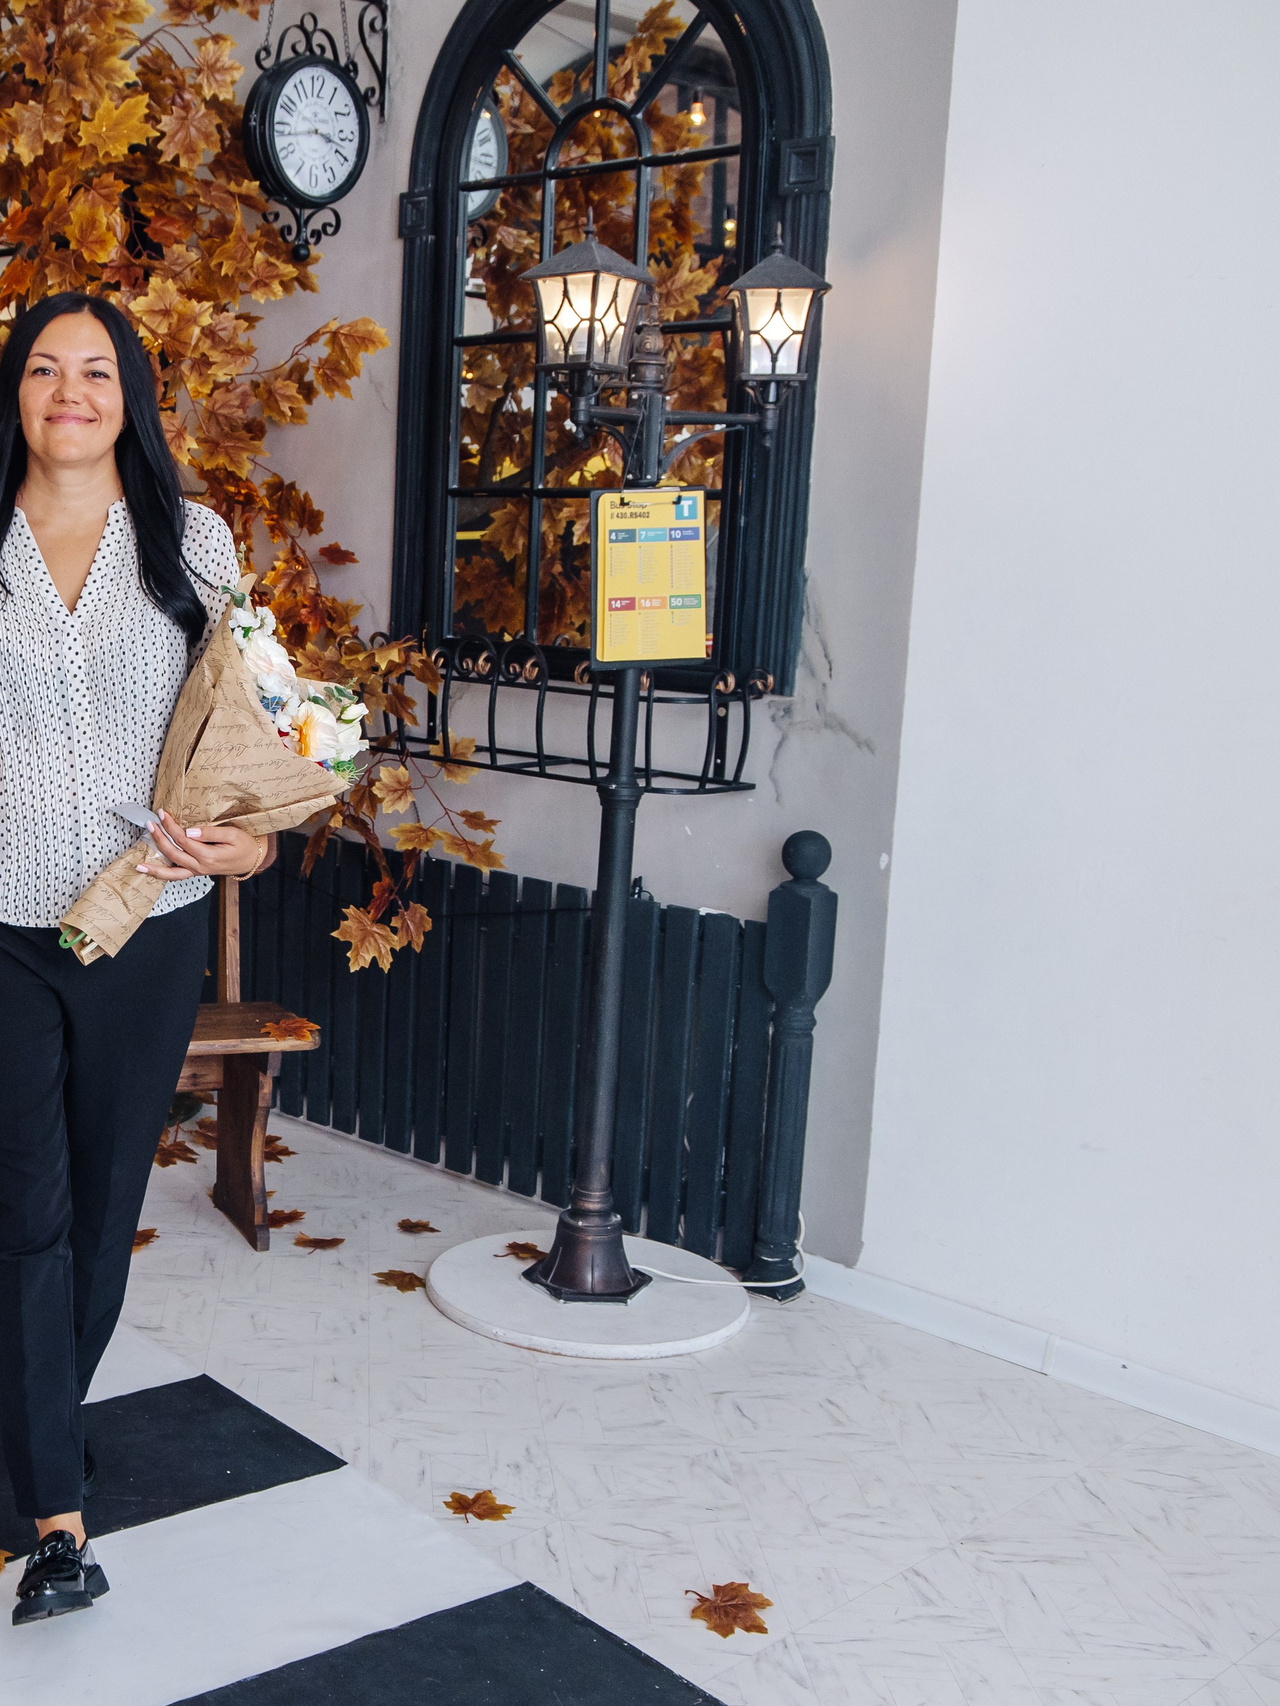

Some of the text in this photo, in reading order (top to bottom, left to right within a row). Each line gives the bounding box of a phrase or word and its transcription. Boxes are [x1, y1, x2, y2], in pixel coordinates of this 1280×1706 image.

[293, 77, 309, 103] 11
[310, 74, 325, 100] 12
[328, 86, 338, 106] 1
[280, 94, 297, 117] 10
[334, 103, 351, 123] 2
[275, 121, 292, 135] 9
[338, 129, 355, 143] 3
[279, 141, 296, 160] 8
[334, 149, 349, 167] 4
[294, 158, 305, 178] 7
[309, 164, 319, 189] 6
[322, 160, 336, 184] 5
[610, 532, 617, 540] 4
[640, 531, 647, 540] 7
[670, 530, 682, 539] 10
[610, 600, 621, 608] 14
[640, 599, 651, 607] 16
[670, 597, 682, 606] 50
